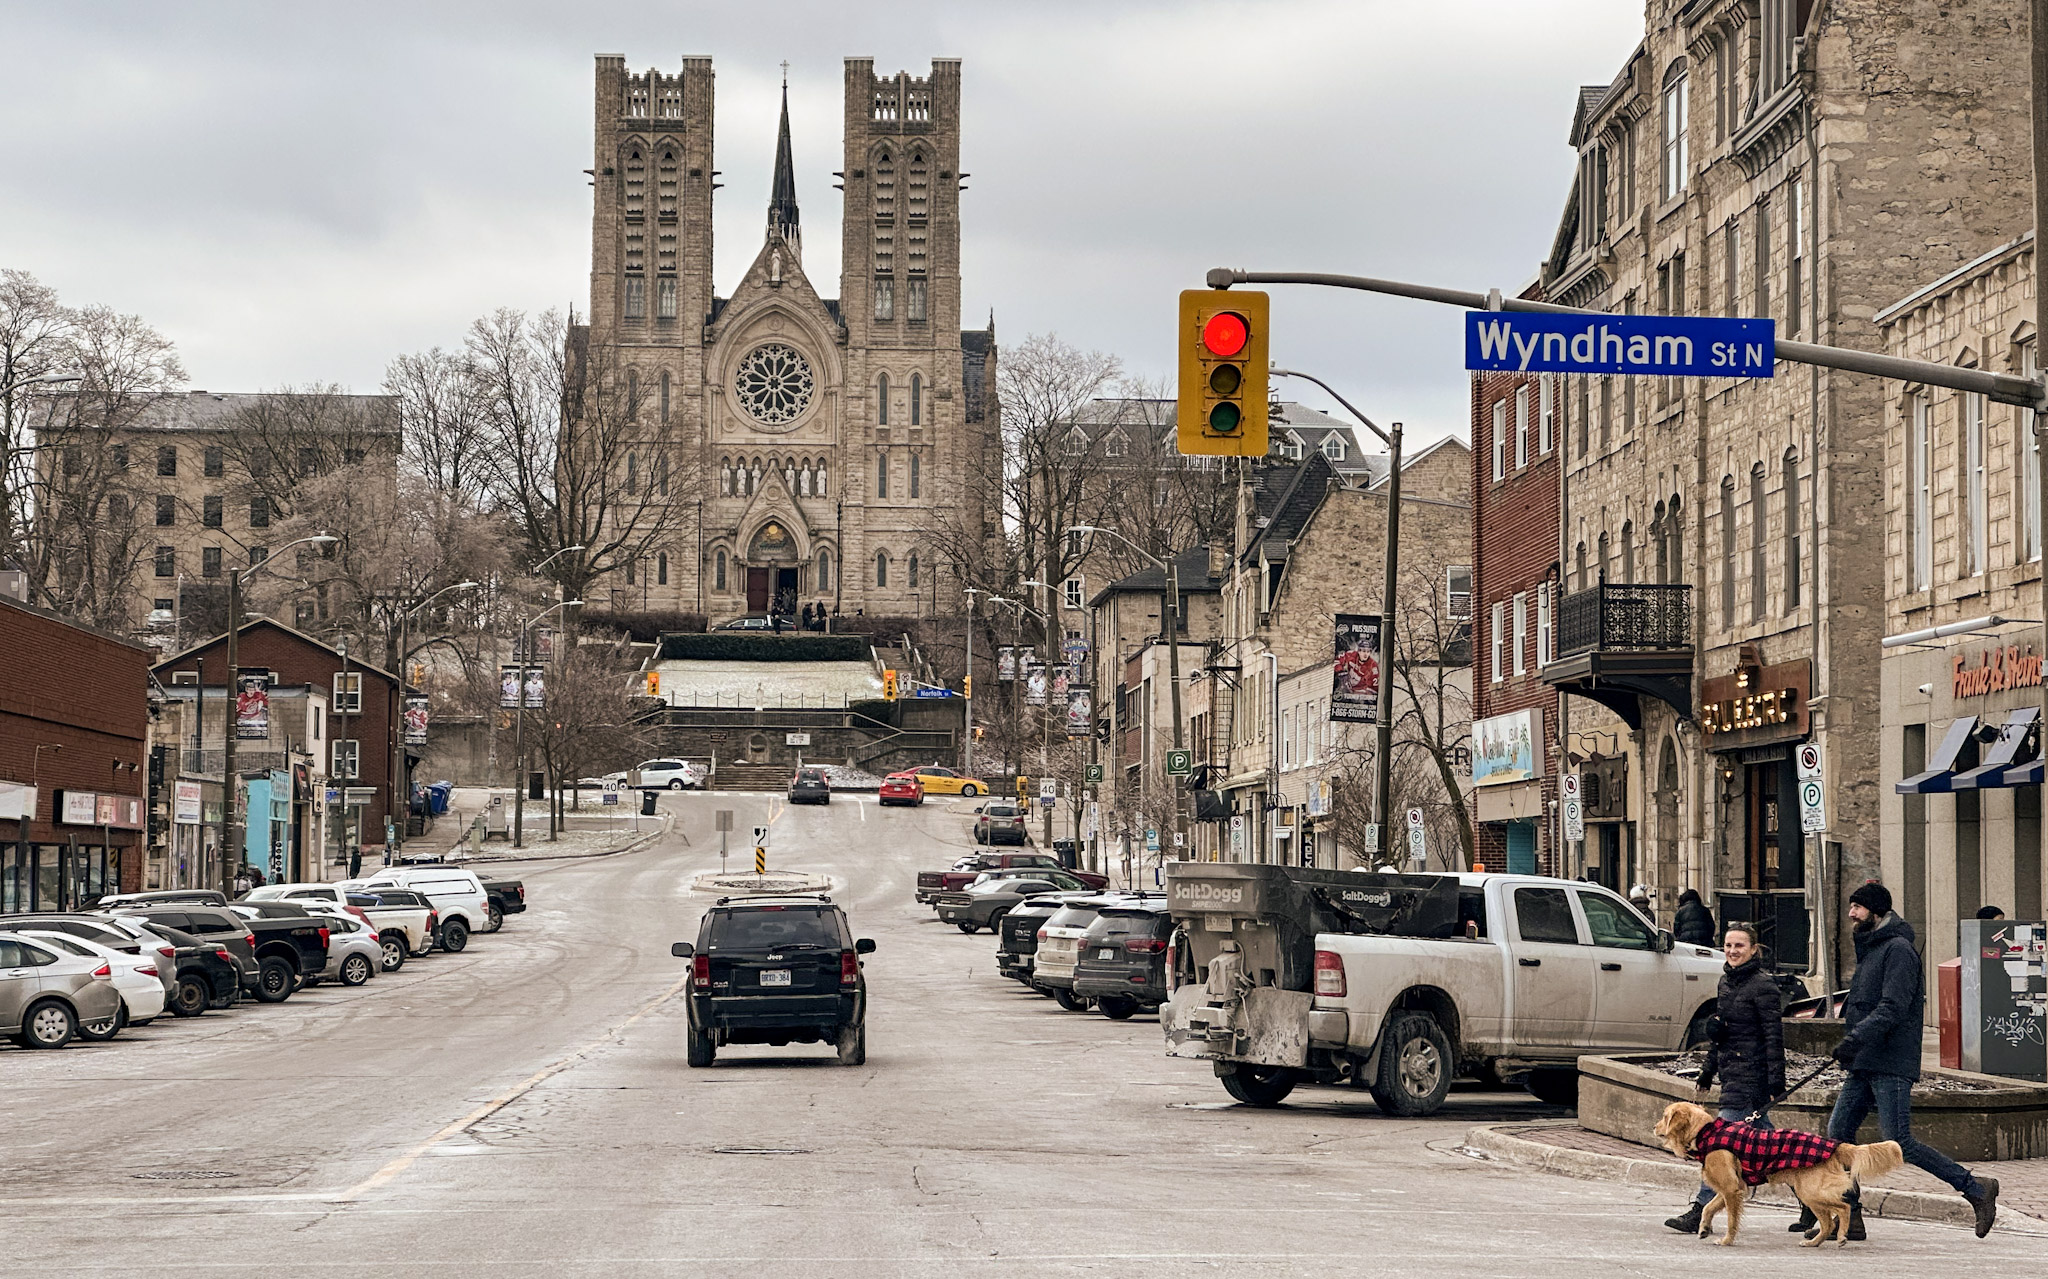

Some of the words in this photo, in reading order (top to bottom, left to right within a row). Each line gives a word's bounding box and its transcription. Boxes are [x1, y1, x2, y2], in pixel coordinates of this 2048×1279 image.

[1477, 321, 1693, 371] Wyndham
[1710, 342, 1736, 367] St
[1746, 343, 1763, 367] N
[1952, 648, 1991, 698] Frank
[1990, 647, 2004, 692] &
[2005, 644, 2044, 690] Steins
[604, 783, 617, 791] 40
[1041, 785, 1055, 794] 40
[1175, 882, 1243, 903] SaltDogg
[1342, 890, 1381, 904] SaltDogg
